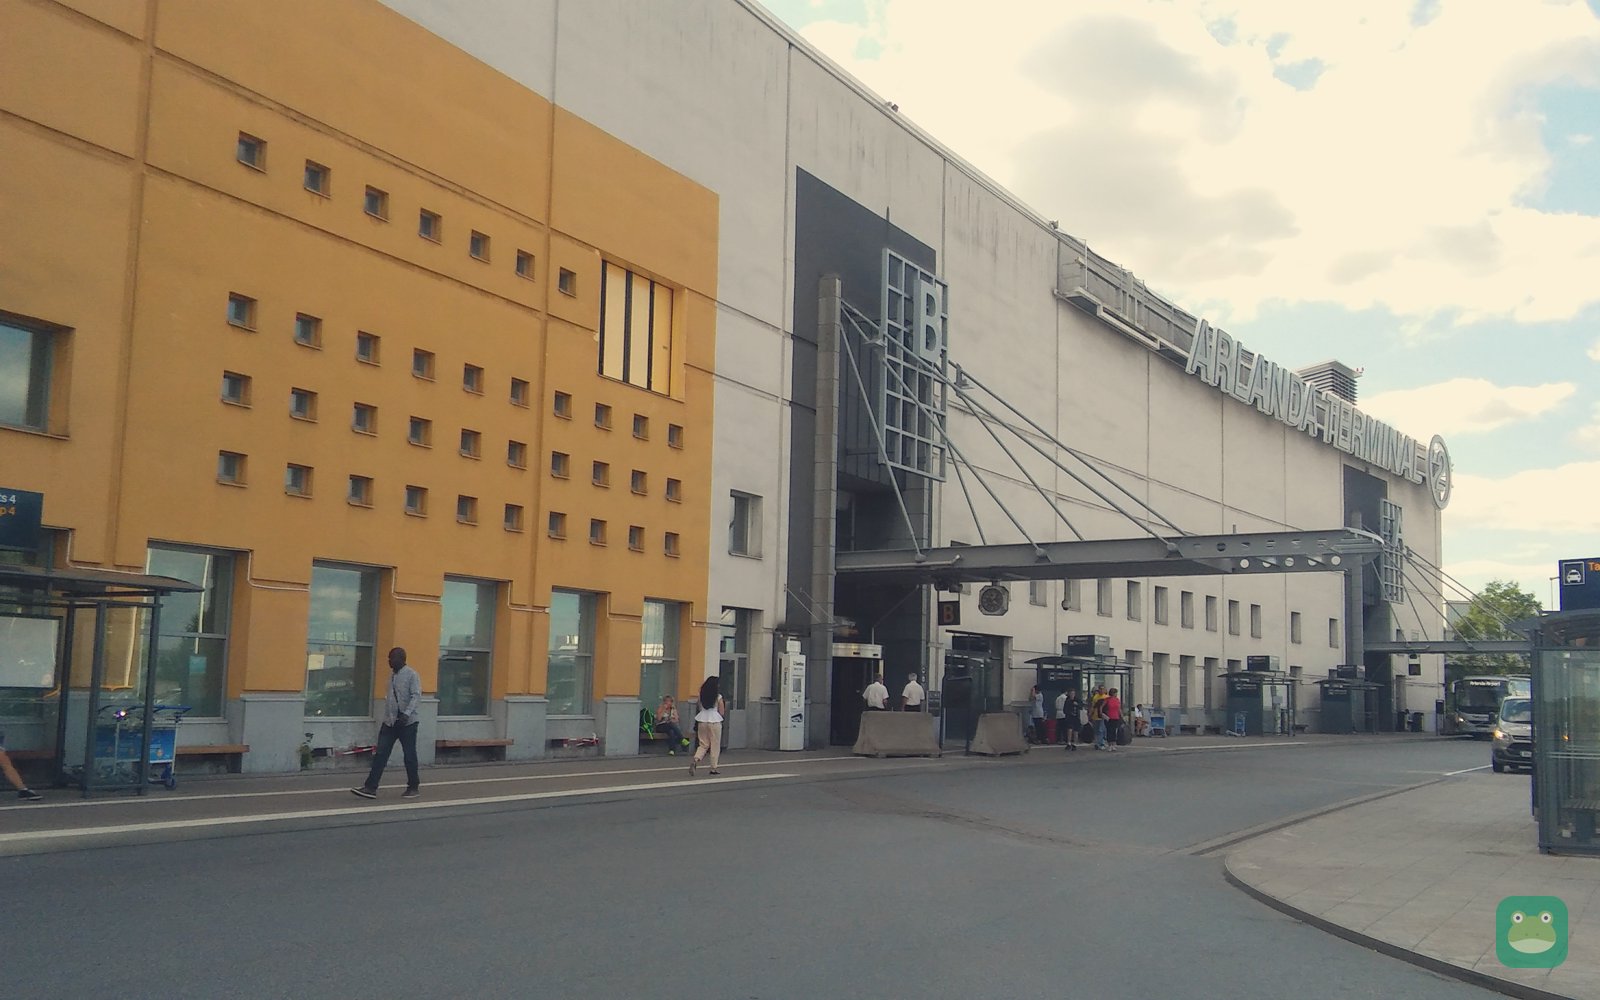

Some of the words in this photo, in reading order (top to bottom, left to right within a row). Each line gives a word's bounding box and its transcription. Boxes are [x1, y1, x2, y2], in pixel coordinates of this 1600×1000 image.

[913, 278, 942, 364] B
[1185, 318, 1319, 438] ARLANDA
[1320, 391, 1424, 484] TERMINAL
[9, 494, 16, 504] 4
[943, 603, 954, 623] B
